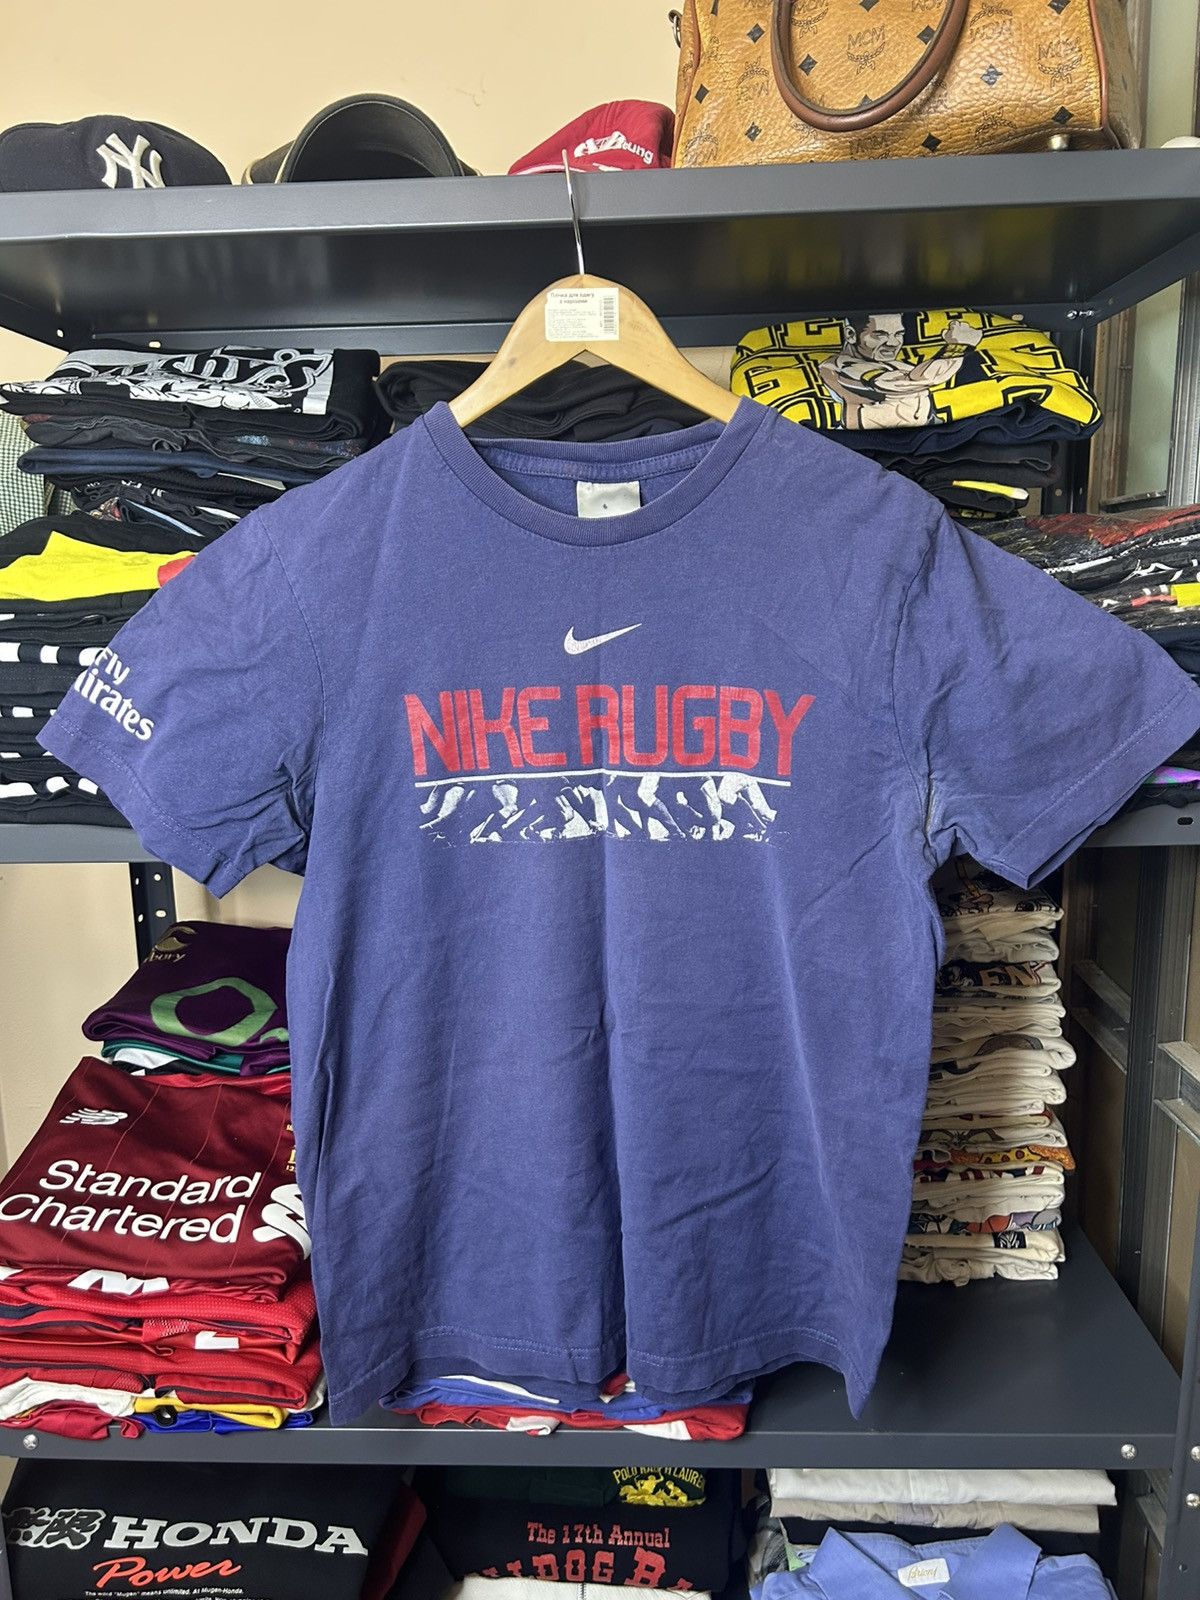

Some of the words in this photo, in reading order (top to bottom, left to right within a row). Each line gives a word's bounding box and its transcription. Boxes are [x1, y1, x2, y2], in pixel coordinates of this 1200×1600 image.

[74, 668, 154, 741] irates
[404, 686, 567, 776] NIKE
[575, 685, 816, 776] RUGBY
[39, 1159, 261, 1205] Standard
[0, 1193, 246, 1244] Chartered
[103, 1515, 368, 1556] HONDA
[527, 1521, 557, 1545] The
[562, 1523, 603, 1545] 17th
[608, 1524, 671, 1548] Annual
[93, 1556, 242, 1588] Power
